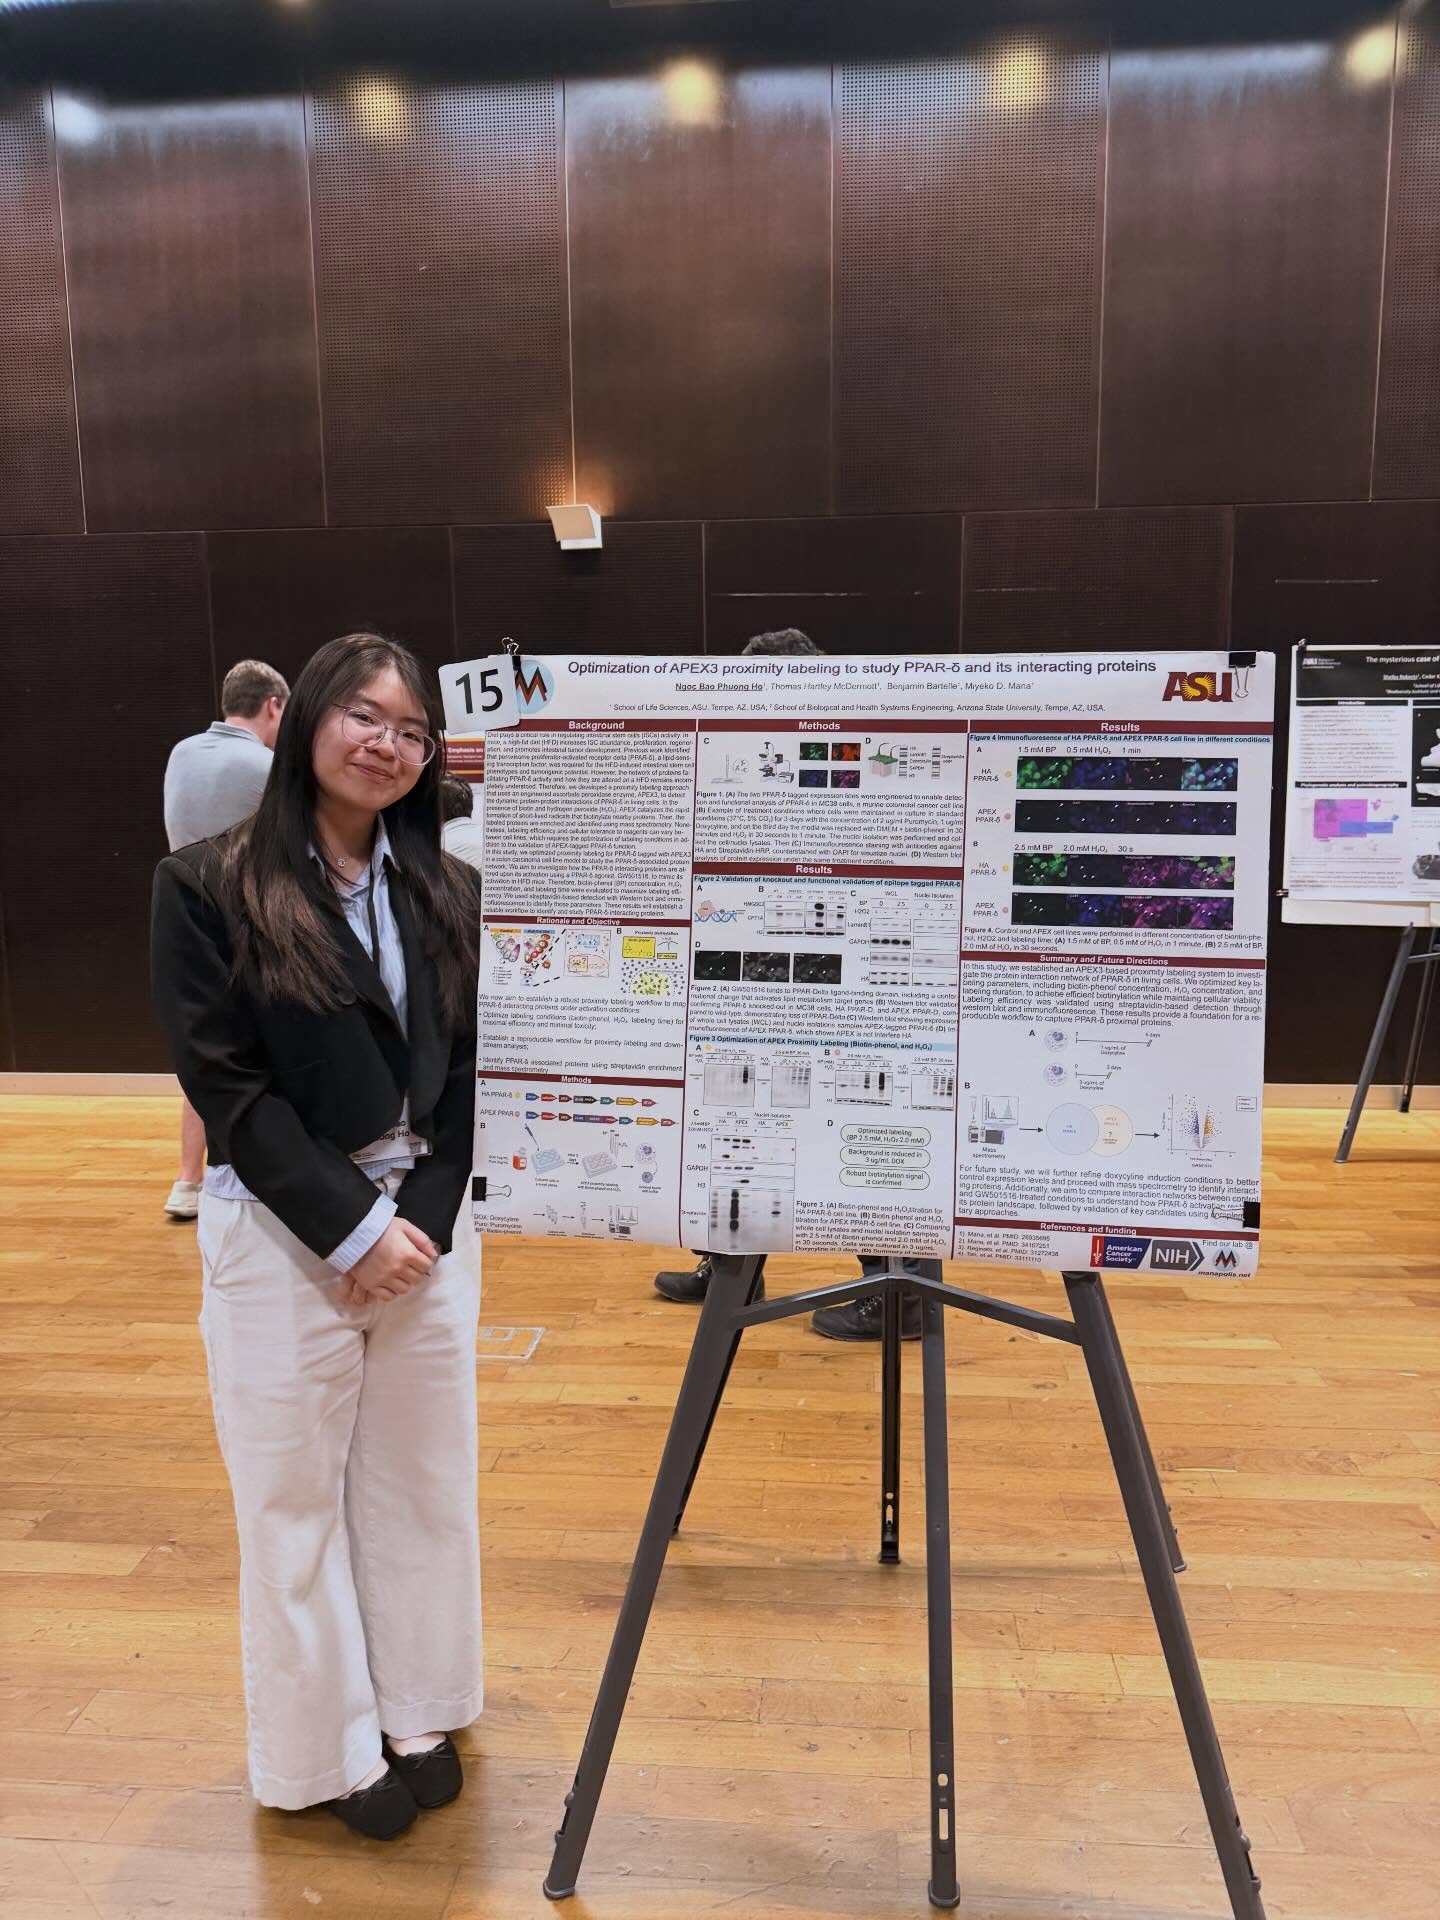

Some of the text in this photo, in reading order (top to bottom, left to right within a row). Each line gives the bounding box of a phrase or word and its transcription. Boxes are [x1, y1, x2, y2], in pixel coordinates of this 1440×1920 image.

[1379, 655, 1415, 664] mysterious
[568, 662, 651, 676] Optimization
[654, 662, 667, 673] of
[669, 662, 719, 673] APEX3
[722, 662, 784, 676] proximity
[787, 662, 841, 676] labeling
[844, 662, 858, 672] to
[861, 662, 900, 675] study
[964, 661, 991, 672] and
[996, 661, 1012, 672] its
[1016, 661, 1093, 675] interacting
[1097, 661, 1157, 675] proteins
[455, 668, 503, 714] 15
[1162, 671, 1233, 702] ASU
[569, 721, 624, 731] Background
[799, 722, 840, 730] Methods
[1100, 722, 1140, 732] Results
[796, 866, 833, 874] Results
[586, 918, 620, 927] Objective
[1040, 955, 1078, 964] Summary
[1097, 956, 1124, 964] Future
[1126, 957, 1168, 965] Directions
[561, 1076, 592, 1084] Methods
[1041, 1223, 1137, 1236] References and funding
[1106, 1244, 1142, 1253] American
[1155, 1248, 1190, 1264] NIH
[1198, 1270, 1251, 1278] manapolis.net
